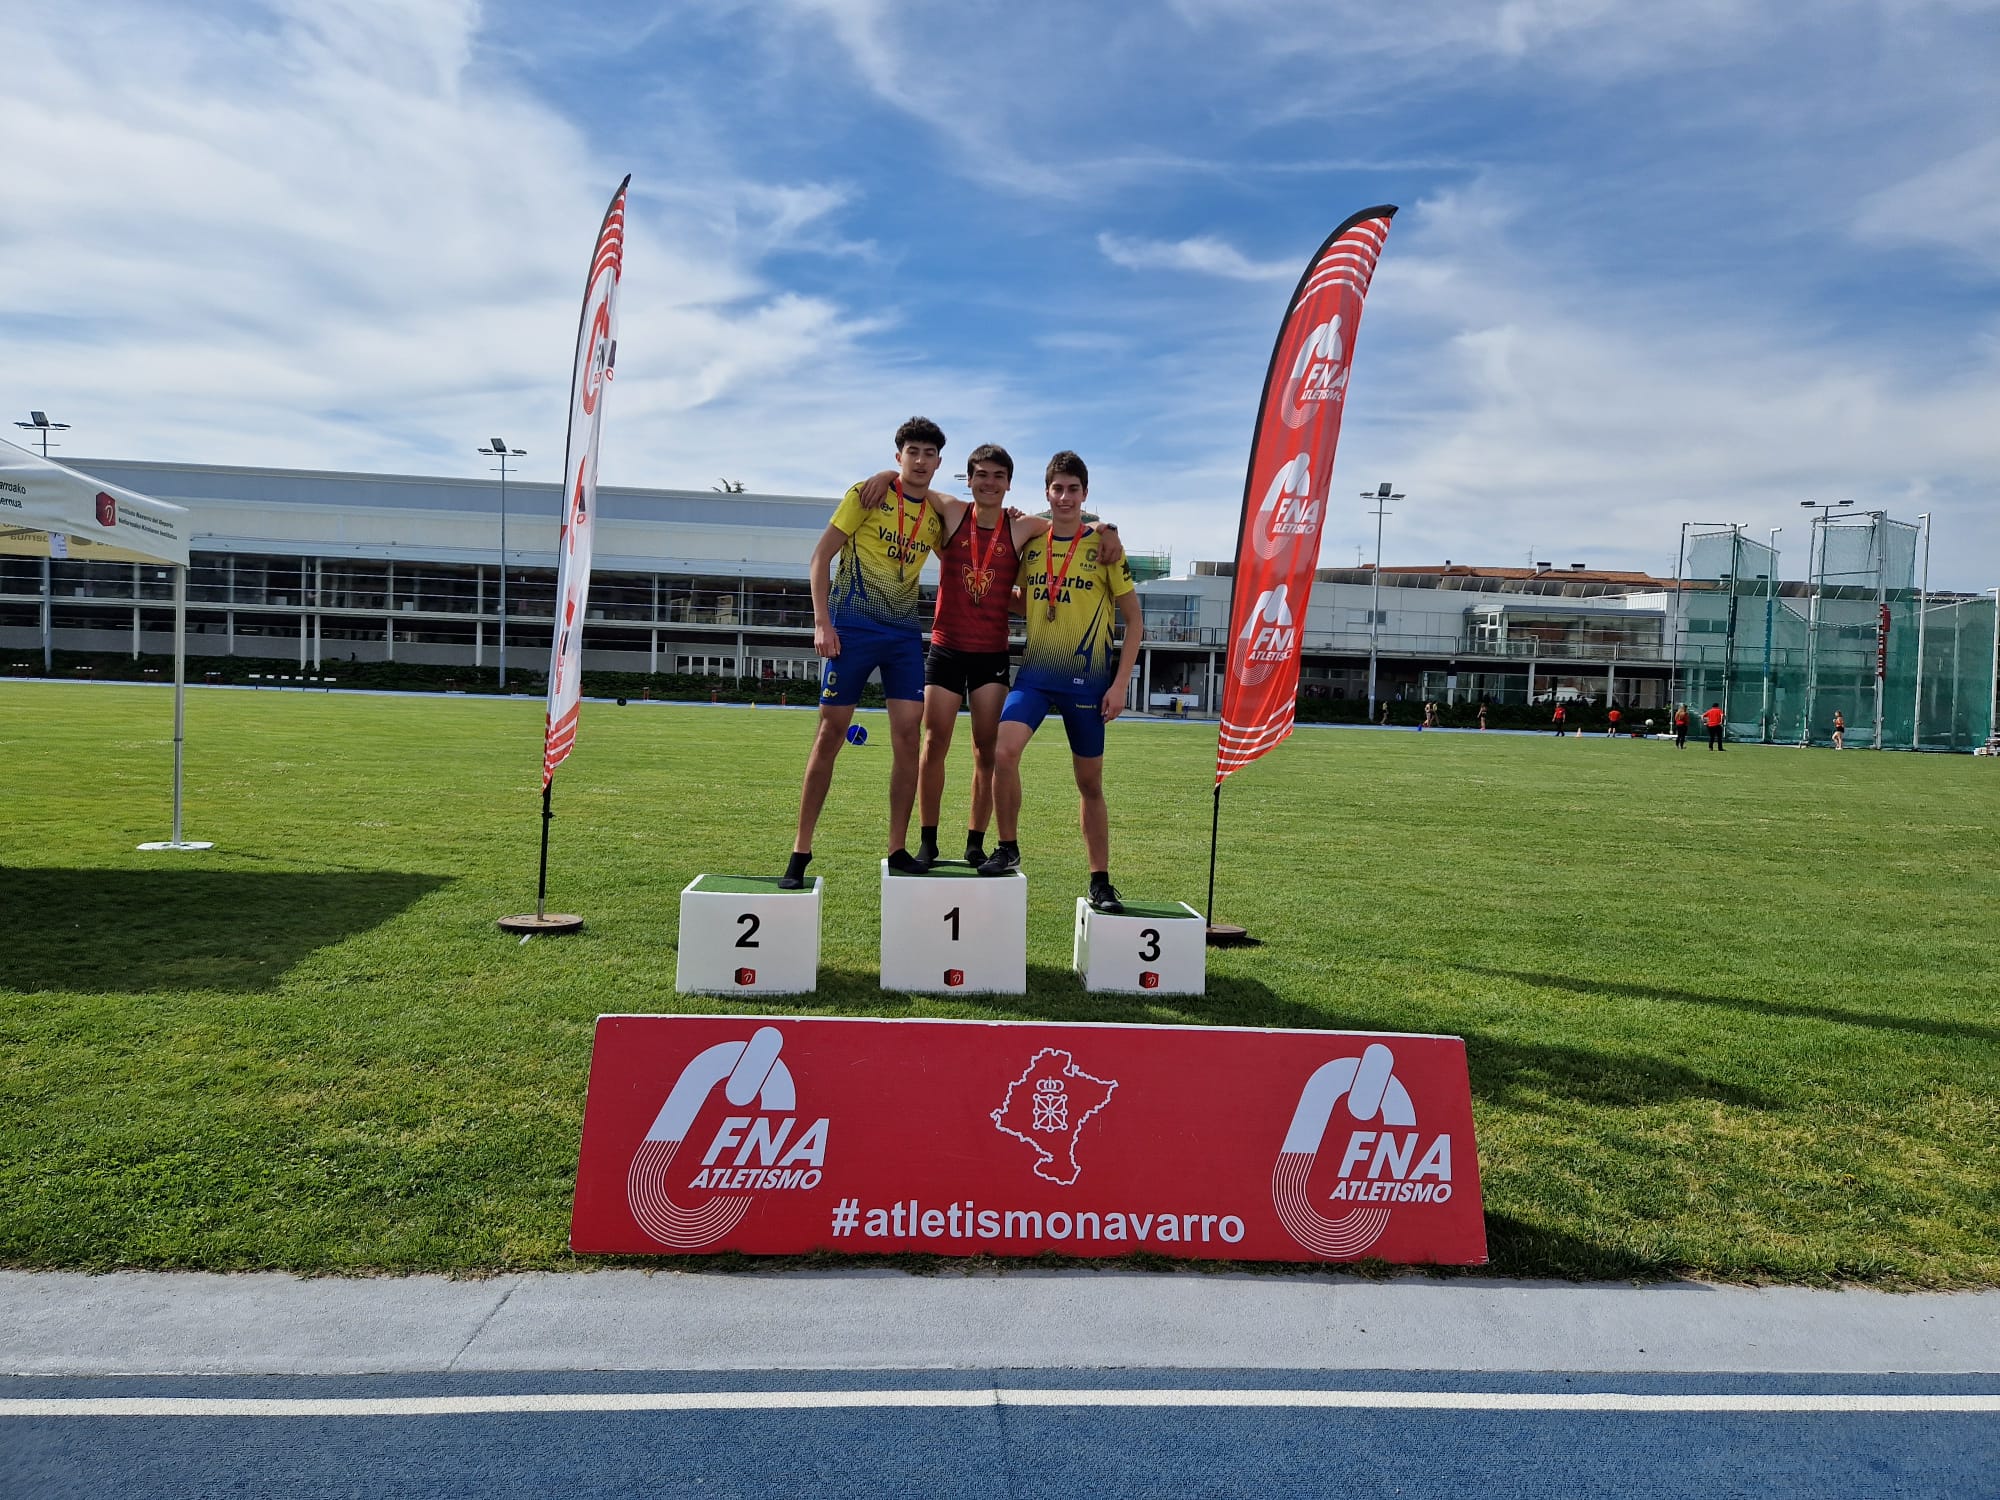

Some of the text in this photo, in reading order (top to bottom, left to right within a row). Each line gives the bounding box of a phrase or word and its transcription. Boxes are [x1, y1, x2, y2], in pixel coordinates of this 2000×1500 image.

[1305, 363, 1349, 390] FNA
[0, 497, 23, 509] ernua
[1275, 498, 1321, 523] FNA
[735, 913, 761, 948] 2
[943, 906, 961, 942] 1
[1138, 928, 1161, 962] 3
[700, 1116, 831, 1168] FNA
[1337, 1130, 1453, 1182] FNA
[687, 1168, 823, 1190] ATLETISMO
[1328, 1180, 1453, 1205] ATLETISMO
[831, 1198, 1246, 1243] #atletismonavarro
